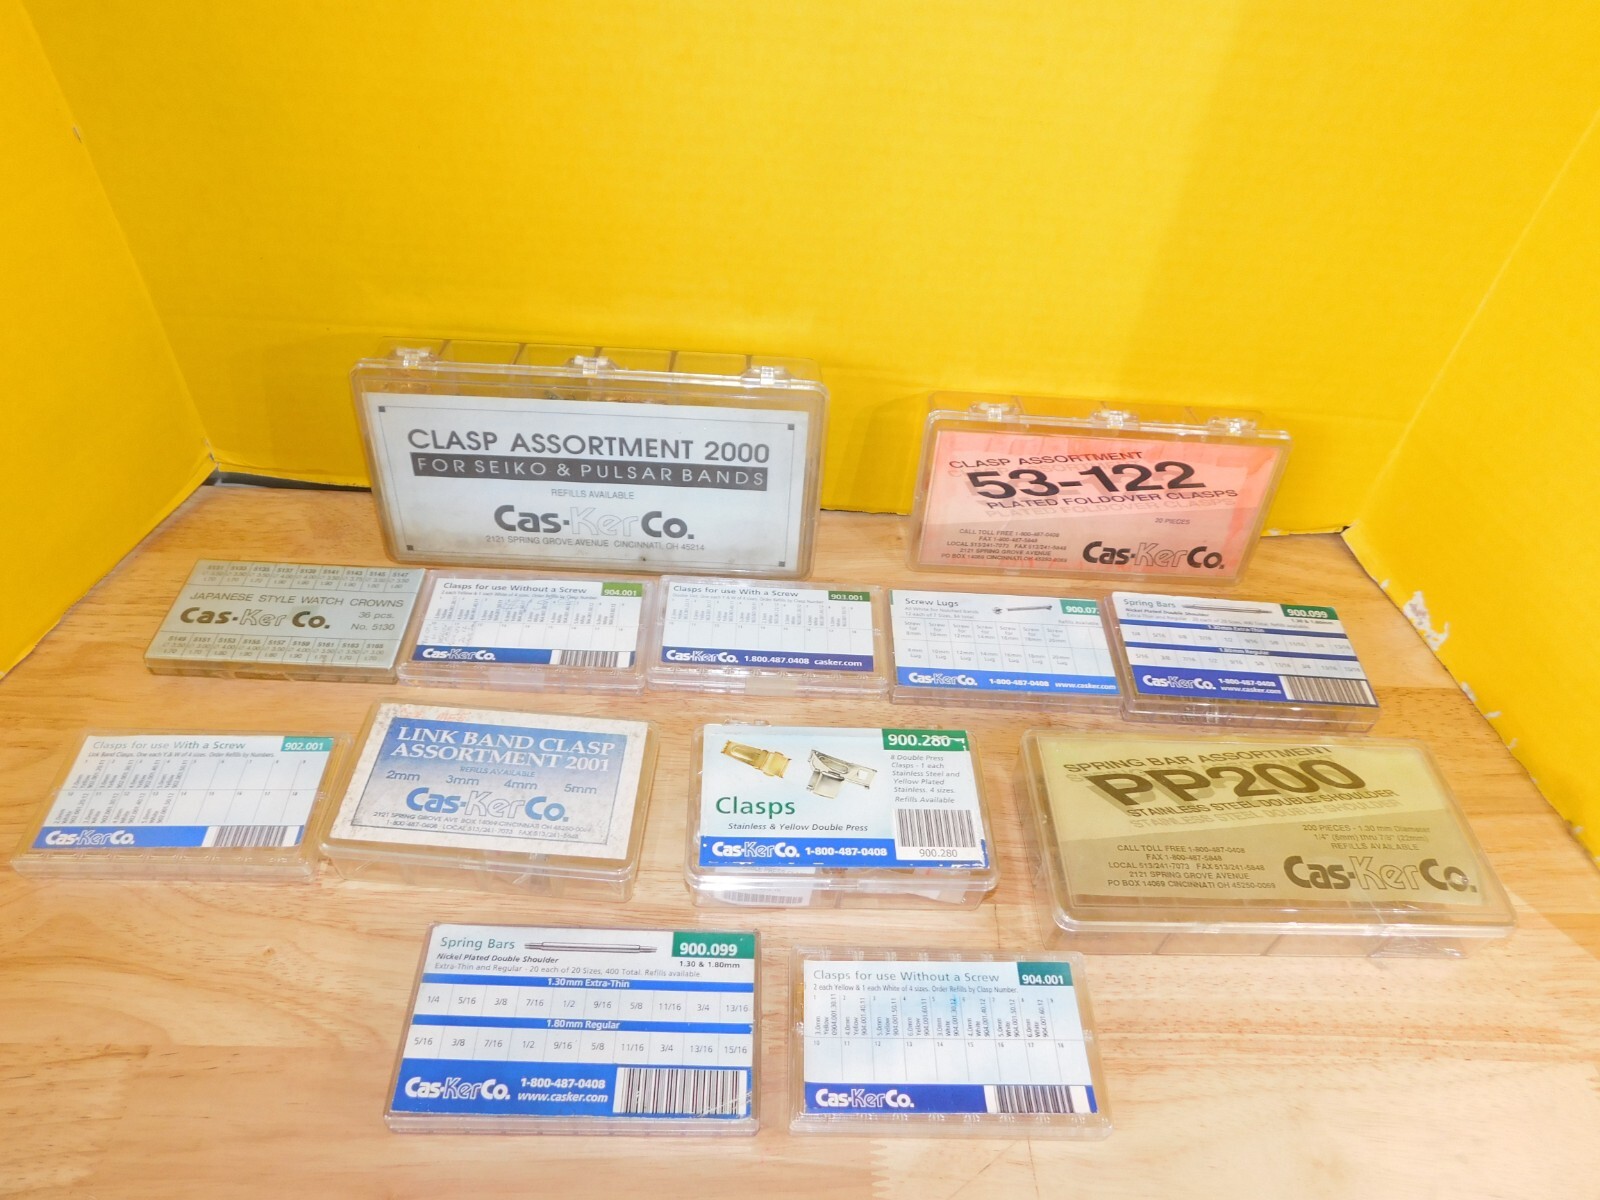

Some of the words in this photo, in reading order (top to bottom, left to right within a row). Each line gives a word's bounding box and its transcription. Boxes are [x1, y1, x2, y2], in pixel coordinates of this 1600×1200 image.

[408, 429, 497, 450] CLASP
[510, 433, 693, 459] ASSORTMENT
[705, 441, 769, 463] 2000
[949, 459, 1010, 469] CLASP
[1018, 452, 1142, 465] ASSORTMENT
[417, 458, 465, 472] FOR
[475, 460, 546, 475] SEIKO
[557, 463, 570, 476] &
[581, 464, 672, 481] PULSAR
[682, 469, 764, 485] BANDS
[966, 461, 1206, 499] 53-122
[551, 489, 586, 498] REFILLS
[588, 489, 635, 499] AVAILABLE
[986, 499, 1058, 509] PLATED
[1062, 493, 1161, 505] FOLDOVER
[1166, 490, 1238, 500] CLASPS
[508, 536, 540, 544] SPRING
[574, 538, 609, 547] AVENUE
[444, 583, 472, 591] Clasps
[510, 585, 548, 593] Without
[604, 589, 637, 597] 904.001
[673, 585, 702, 593] Clasps
[705, 586, 718, 594] for
[190, 592, 254, 601] JAPANESE
[258, 595, 296, 603] STYLE
[301, 596, 344, 605] WATCH
[349, 599, 403, 607] CROWNS
[831, 593, 863, 601] 903.001
[905, 598, 933, 606] Screw
[1124, 599, 1154, 609] Spring
[1156, 600, 1176, 608] Bars
[1066, 606, 1100, 614] 900.07
[1287, 609, 1328, 618] 900.099
[373, 612, 394, 620] pcs.
[351, 623, 368, 631] No.
[744, 656, 809, 665] 1.800.487.0408
[814, 659, 862, 667] casker.com
[94, 741, 127, 750] Clasps
[131, 741, 147, 749] for
[173, 741, 200, 749] With
[214, 741, 246, 749] Screw
[397, 727, 458, 744] LINK
[462, 731, 534, 749] BAND
[539, 738, 615, 755] CLASP
[888, 734, 950, 746] 900.280
[285, 742, 324, 750] 902.001
[390, 742, 563, 768] ASSORTMENT
[565, 757, 608, 772] 2001
[1064, 758, 1145, 773] SPRING
[1146, 756, 1193, 766] BAR
[1198, 747, 1332, 763] ASSORTMENT
[386, 770, 420, 781] 2mm
[446, 775, 479, 786] 3mm
[504, 780, 537, 790] 4mm
[564, 784, 597, 794] 5mm
[1084, 759, 1366, 806] PP200
[716, 796, 795, 819] Clasps
[1127, 804, 1210, 817] STAINLESS
[1209, 800, 1255, 811] STEEL
[1263, 795, 1323, 808] DOUBLE
[1322, 789, 1400, 803] SHOULDER
[779, 823, 810, 831] Yellow
[805, 847, 887, 856] 1-800-487-0408
[919, 849, 958, 858] 900.280
[440, 937, 482, 951] Spring
[488, 939, 515, 949] Bars
[680, 942, 737, 956] 900.099
[814, 970, 851, 981] Clasps
[856, 971, 872, 980] for
[900, 971, 949, 981] Without
[965, 973, 999, 982] Screw
[1022, 975, 1064, 984] 904.001
[548, 978, 583, 986] 1.30mm
[585, 979, 630, 988] Extra-Thin
[594, 1001, 612, 1009] 9/16
[659, 1003, 681, 1011] 11/16
[697, 1003, 710, 1011] 3/4
[726, 1004, 748, 1012] 13/16
[547, 1019, 582, 1028] 1.80mm
[585, 1021, 620, 1031] Regular
[520, 1078, 606, 1089] 1-800-487-0408
[517, 1092, 608, 1103] www.casker.com
